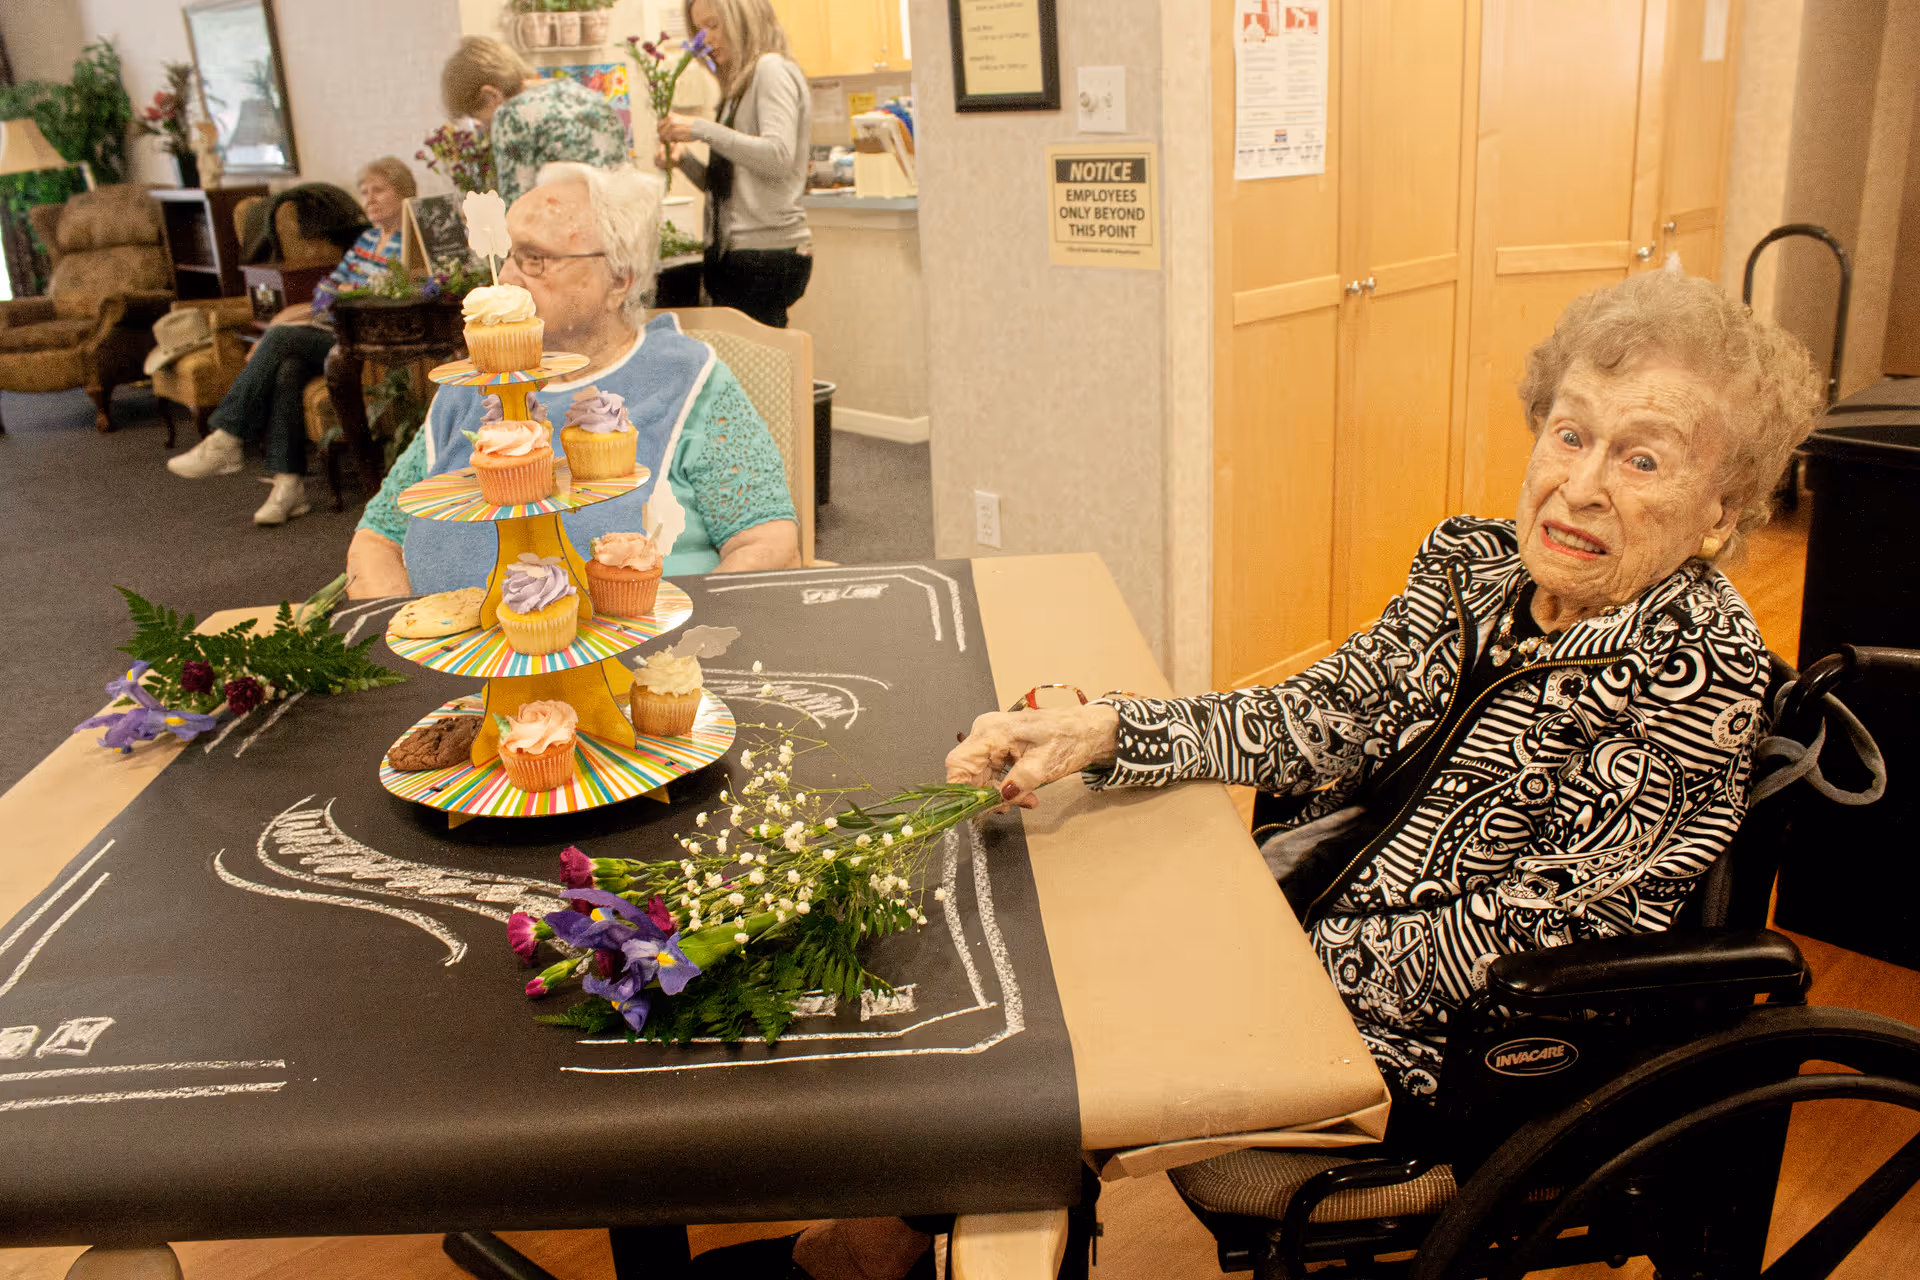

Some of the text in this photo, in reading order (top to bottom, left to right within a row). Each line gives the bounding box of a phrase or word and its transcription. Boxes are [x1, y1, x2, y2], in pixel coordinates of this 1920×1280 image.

[1069, 161, 1132, 181] NOTICE
[1065, 189, 1137, 202] EMPLOYEES
[1059, 206, 1145, 221] ONLY BEYOND
[1069, 223, 1137, 238] THIS POINT
[1496, 1045, 1565, 1068] INVACARE
